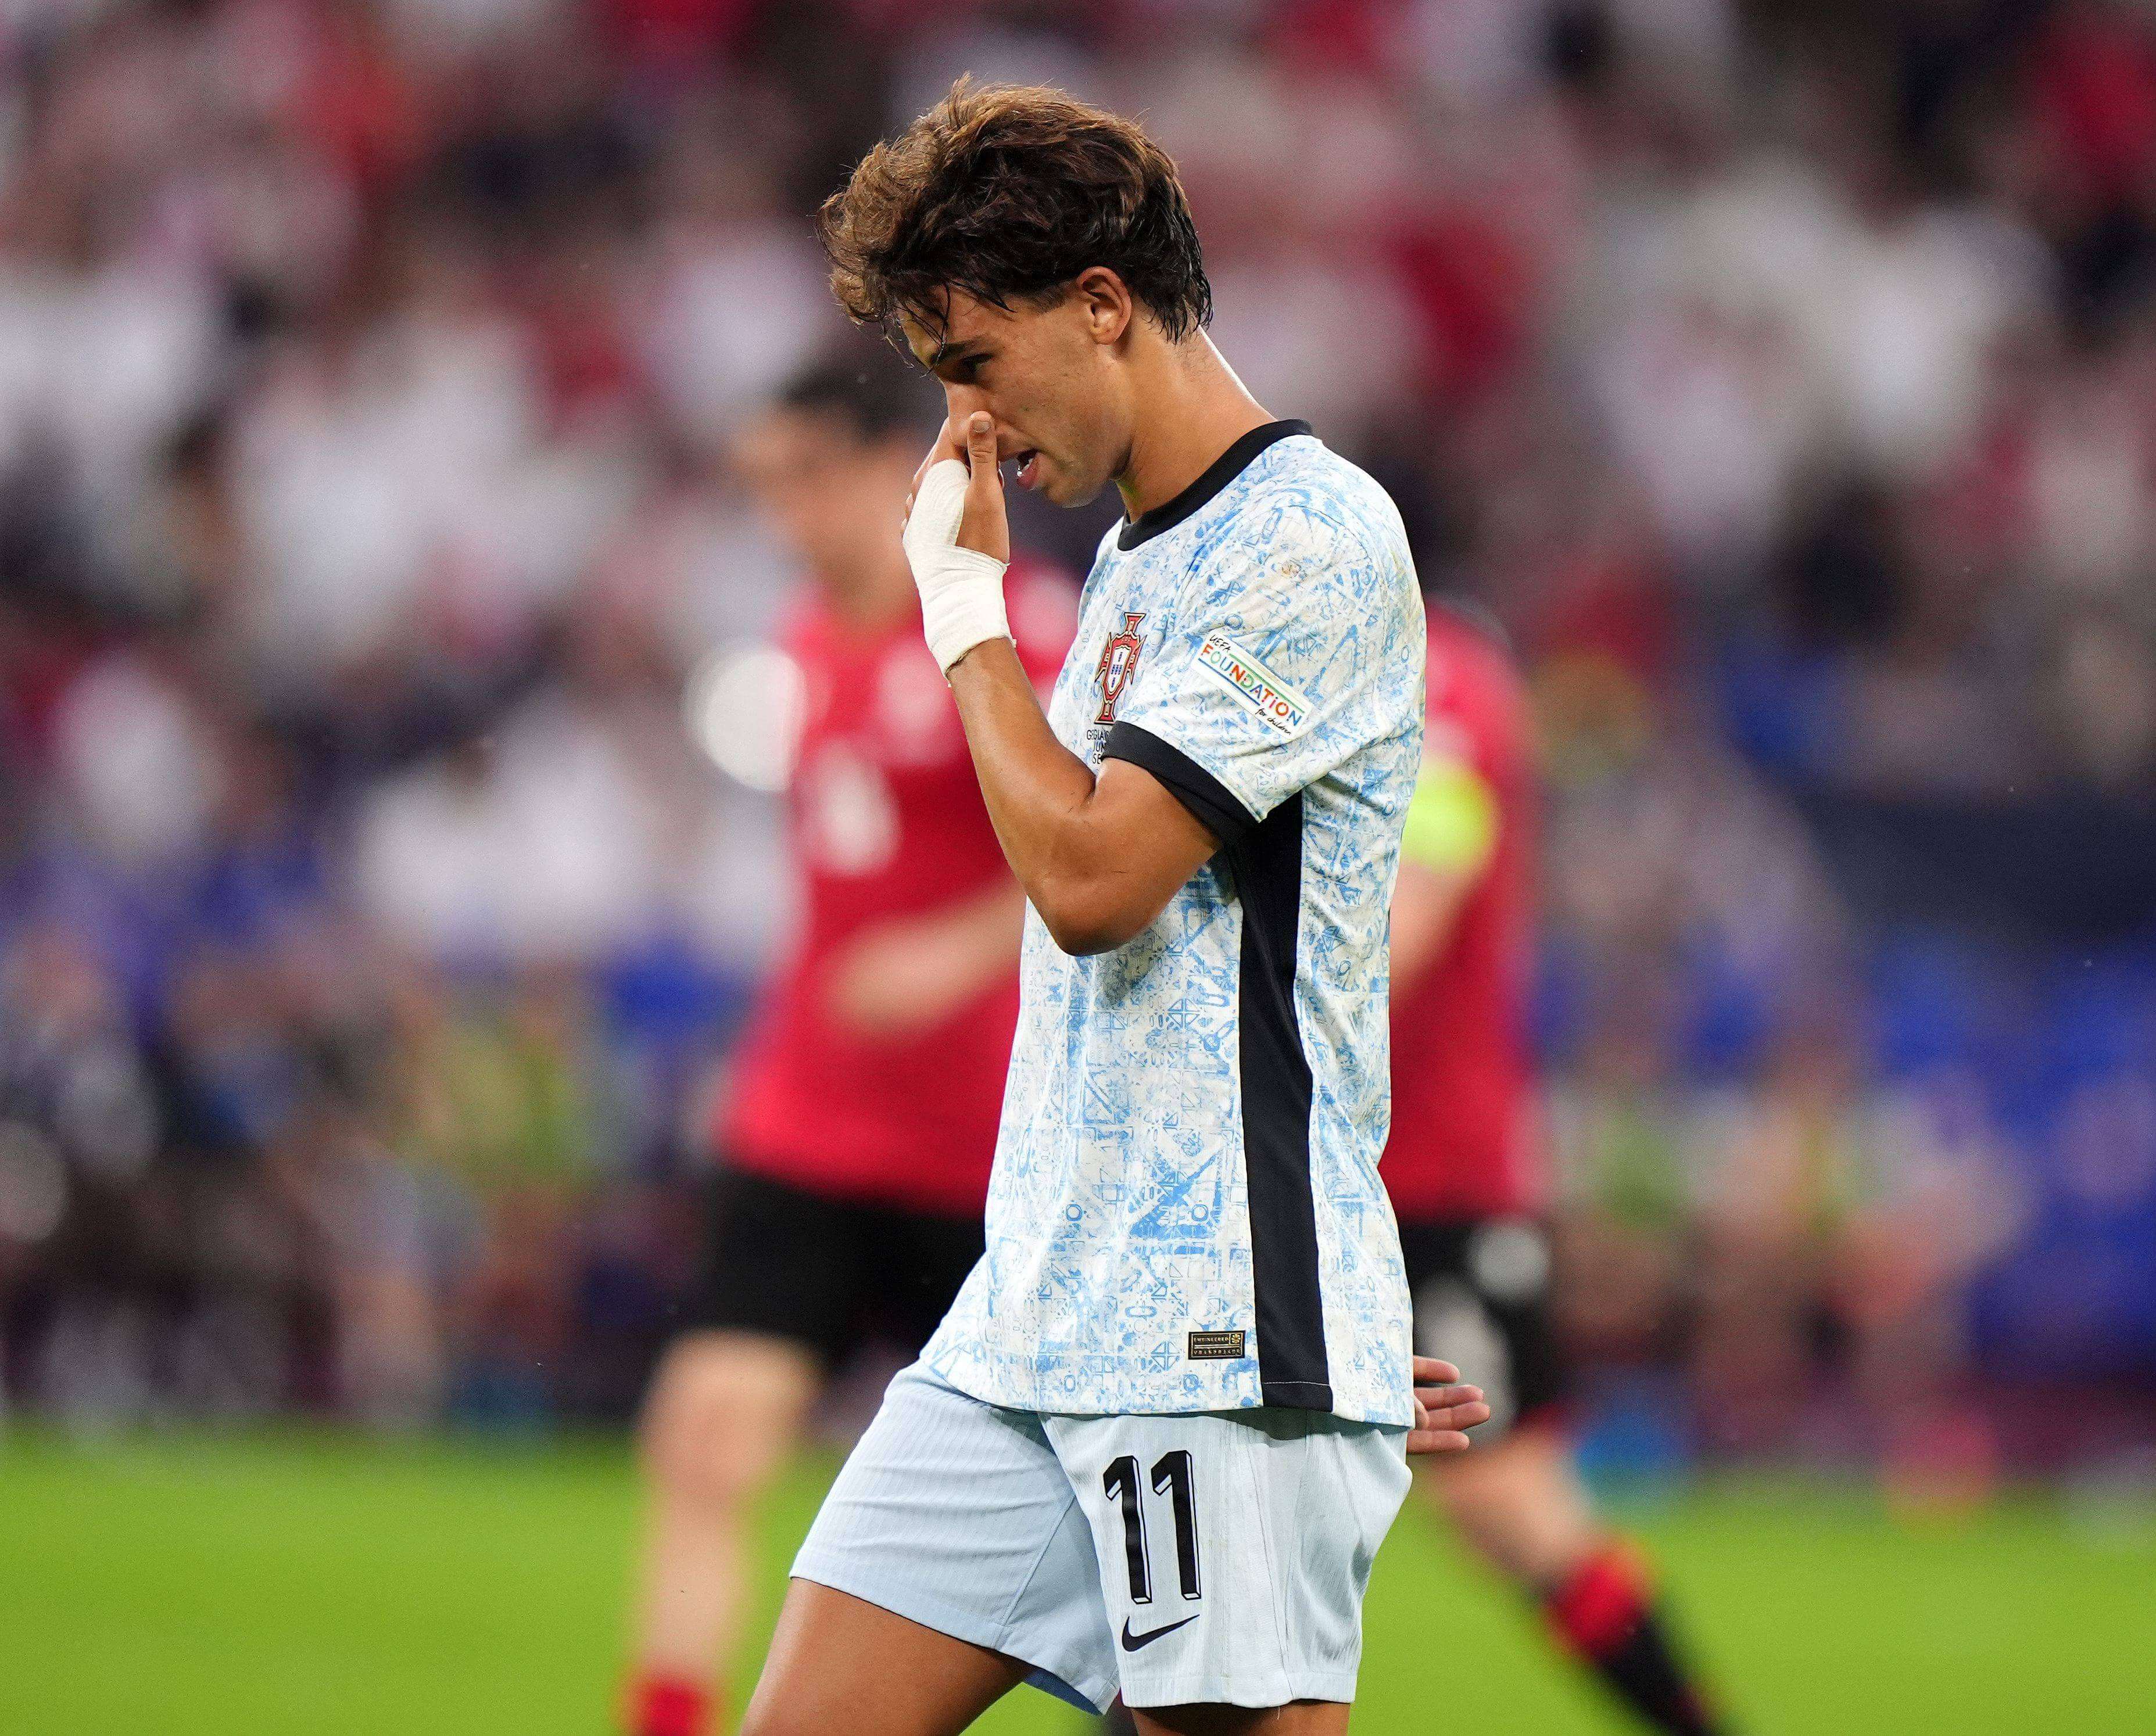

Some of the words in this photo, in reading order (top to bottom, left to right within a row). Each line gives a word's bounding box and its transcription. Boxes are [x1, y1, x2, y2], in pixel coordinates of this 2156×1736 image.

[1209, 634, 1231, 651] UEFA
[1255, 708, 1266, 717] for
[1267, 717, 1292, 735] children
[1103, 1450, 1202, 1605] 11
